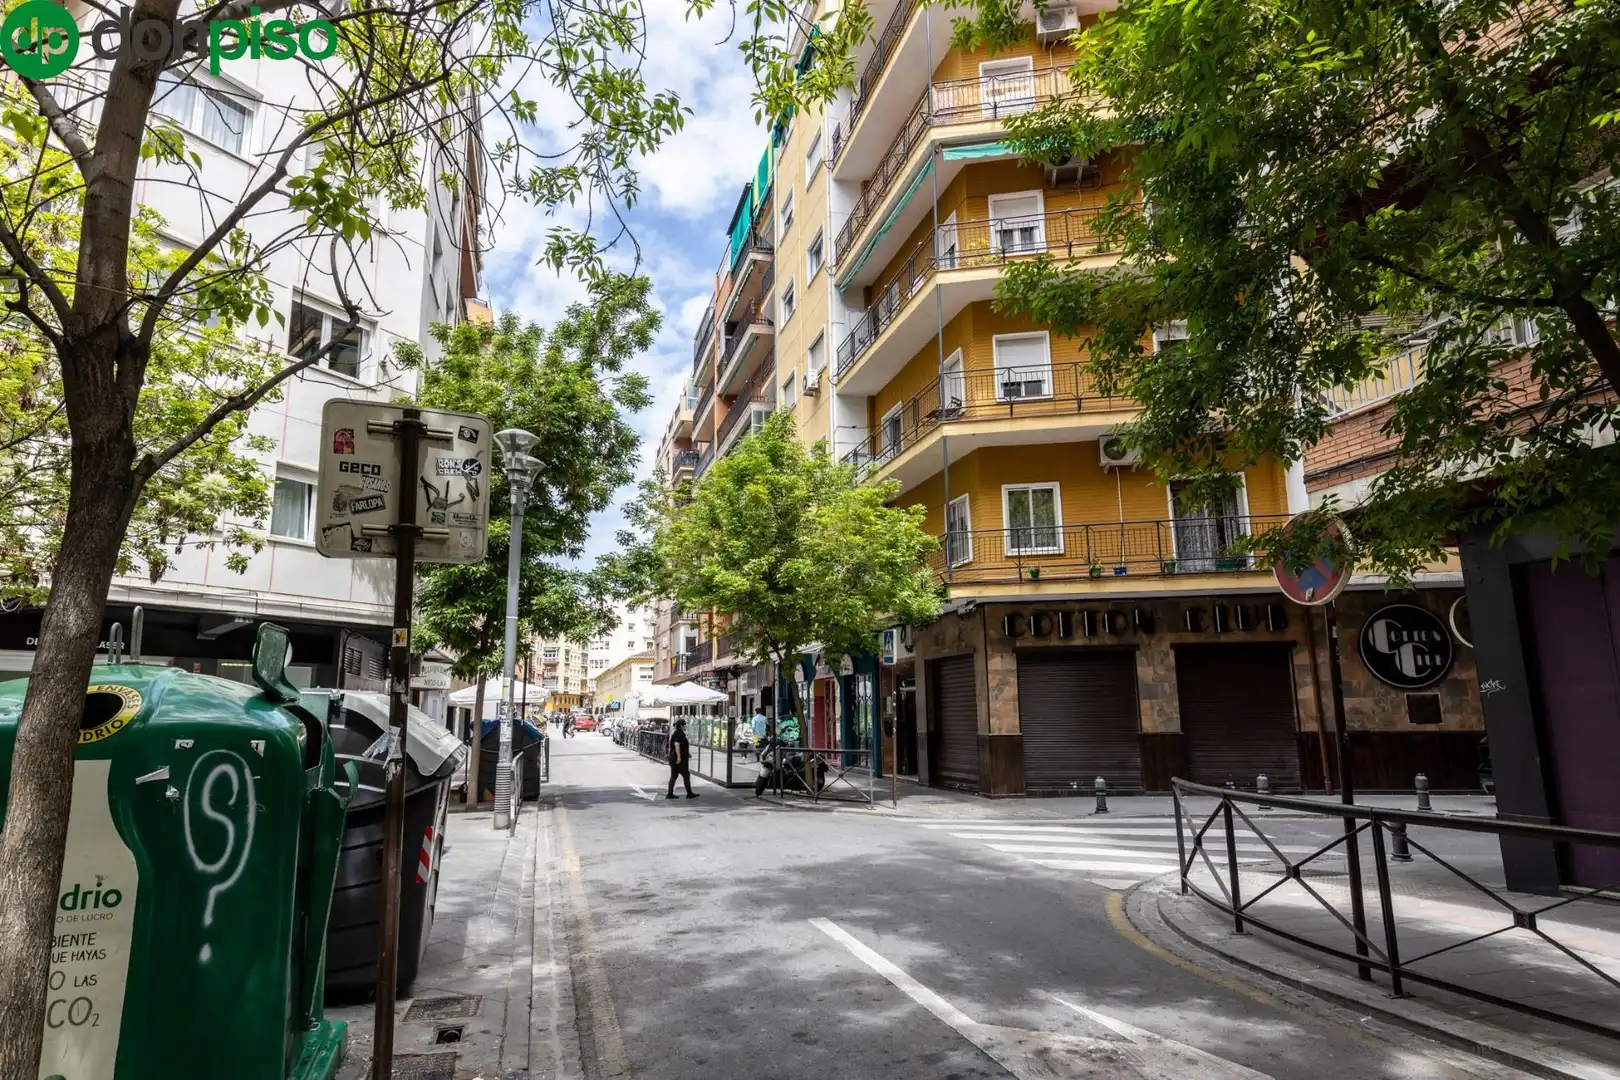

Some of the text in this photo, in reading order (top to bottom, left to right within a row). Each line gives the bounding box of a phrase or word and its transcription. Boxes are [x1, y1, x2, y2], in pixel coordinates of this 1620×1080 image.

[351, 498, 384, 513] FARLOPA
[1002, 602, 1289, 638] COTTON CLUB
[97, 685, 140, 709] ENVASES
[80, 719, 124, 742] DRIO
[60, 882, 122, 911] drio
[81, 913, 113, 922] LUCRO
[51, 932, 97, 948] BIENTE
[51, 949, 107, 963] UE HAYAS
[74, 974, 98, 988] LAS
